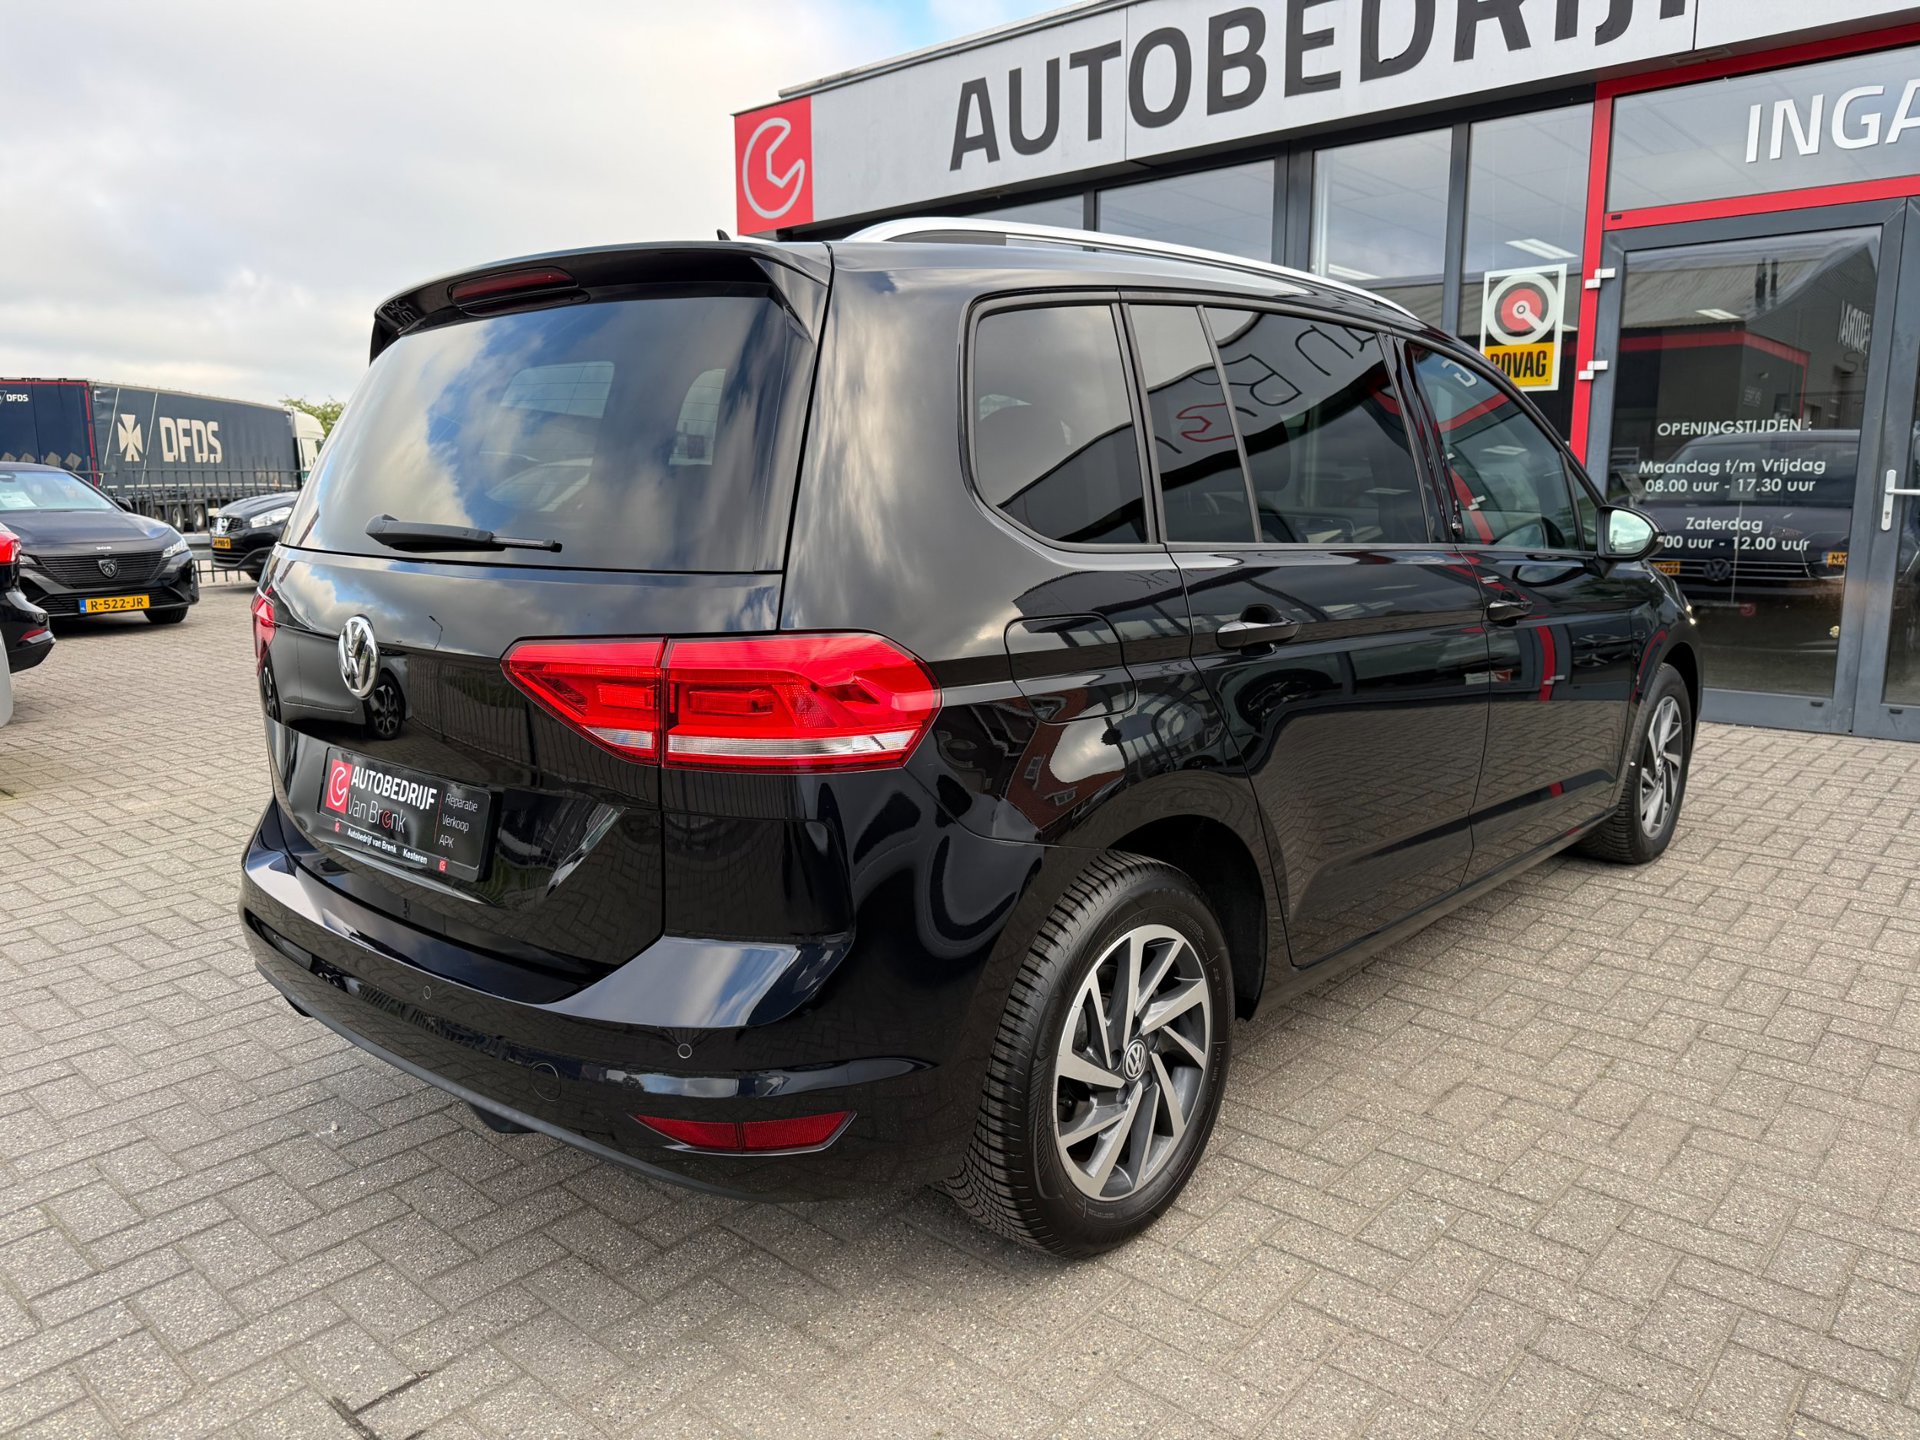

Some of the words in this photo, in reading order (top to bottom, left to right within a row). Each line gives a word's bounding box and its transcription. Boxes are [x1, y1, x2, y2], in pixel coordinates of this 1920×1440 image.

[949, 0, 1686, 171] AUTOBEDR
[6, 394, 29, 402] DFDS
[1657, 419, 1802, 436] OPENINGSTIJDEN
[159, 416, 222, 463] DFDS
[1638, 460, 1720, 476] Maandag
[1725, 459, 1756, 475] t/m
[1762, 458, 1826, 475] Vrijdag
[1645, 479, 1688, 492] 08.00
[1693, 481, 1719, 492] uur
[1737, 478, 1782, 492] 17.30
[1787, 481, 1816, 492] uur
[1685, 517, 1763, 534] Zaterdag
[1687, 539, 1714, 549] uur
[1732, 537, 1776, 550] 12.00
[1781, 539, 1811, 551] uur
[90, 597, 144, 610] R-522-JR
[351, 766, 437, 810] AUTOBEDRIJF
[348, 792, 367, 820] Van
[439, 834, 454, 848] APK
